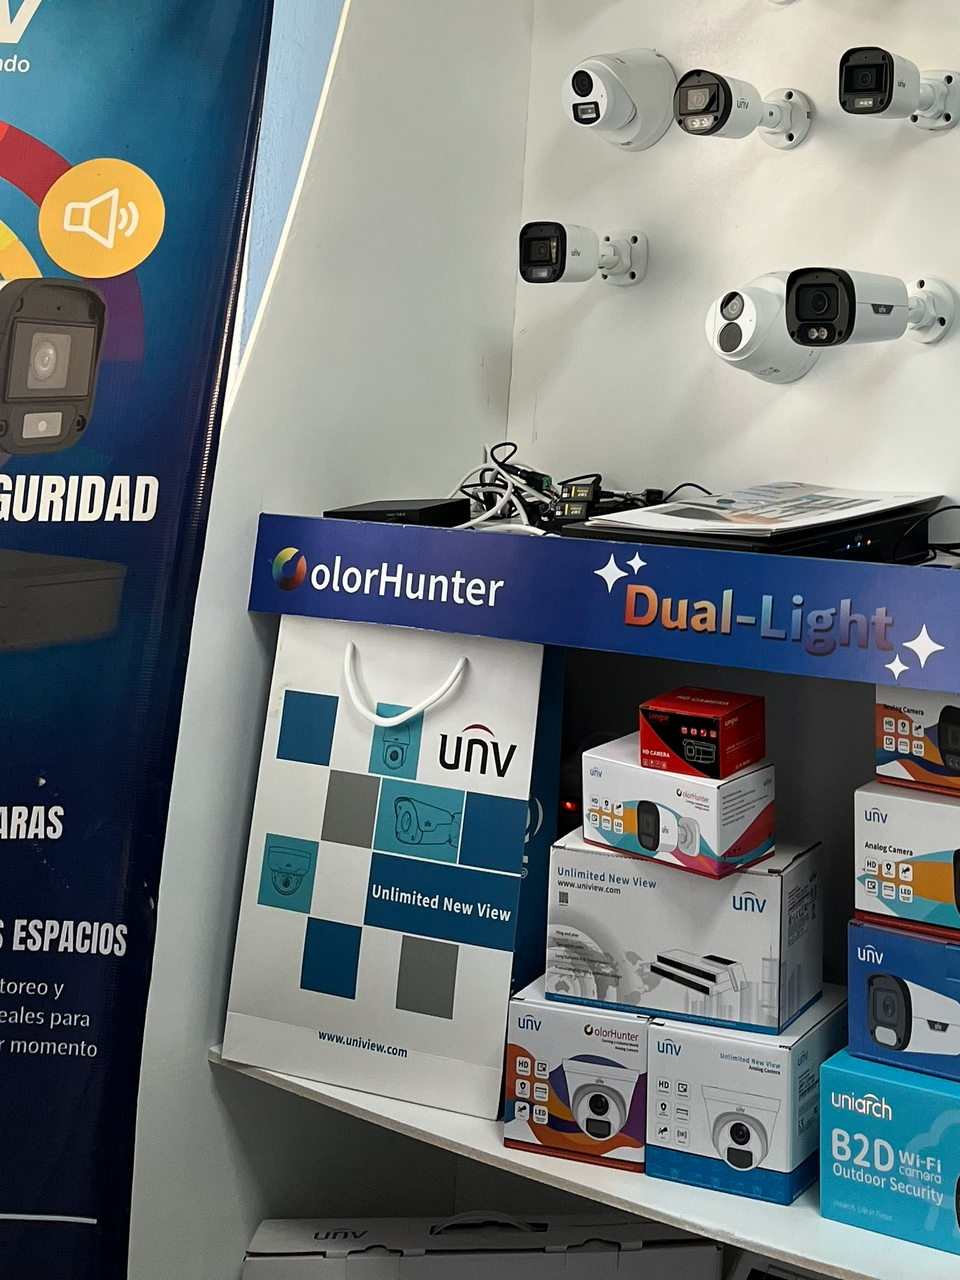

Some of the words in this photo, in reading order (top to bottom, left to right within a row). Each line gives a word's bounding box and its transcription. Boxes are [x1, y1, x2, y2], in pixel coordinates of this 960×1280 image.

[624, 584, 895, 656] Dual-Light
[883, 703, 903, 714] Analog
[903, 706, 925, 717] Camera
[885, 719, 894, 728] HD
[650, 749, 671, 759] CAMERA
[913, 742, 924, 750] LED
[864, 841, 888, 854] Analog
[888, 844, 914, 857] Camera
[866, 860, 877, 869] HD
[557, 866, 606, 883] Unlimited
[608, 873, 630, 886] New
[632, 876, 658, 889] View
[557, 879, 622, 895] www.uniview.com
[900, 888, 912, 896] LED
[371, 884, 439, 912] Unlimited
[442, 894, 475, 917] New
[477, 900, 513, 923] View
[12, 918, 128, 957] ESPACIOS
[53, 982, 65, 1000] y
[50, 1011, 91, 1030] para
[10, 1038, 98, 1058] momento
[318, 1029, 408, 1059] www.uniview.com
[518, 1060, 529, 1069] HD
[720, 1052, 750, 1064] Unlimited
[751, 1058, 764, 1067] New
[765, 1060, 781, 1069] View
[749, 1065, 764, 1074] Analog
[764, 1067, 781, 1075] Camera
[658, 1080, 670, 1089] HD
[535, 1108, 546, 1116] LED
[831, 1091, 893, 1121] uniarch
[831, 1127, 895, 1173] B2D
[899, 1148, 942, 1174] Wi-Fi
[899, 1165, 942, 1185] camera
[832, 1162, 887, 1189] Outdoor
[889, 1176, 944, 1206] Security
